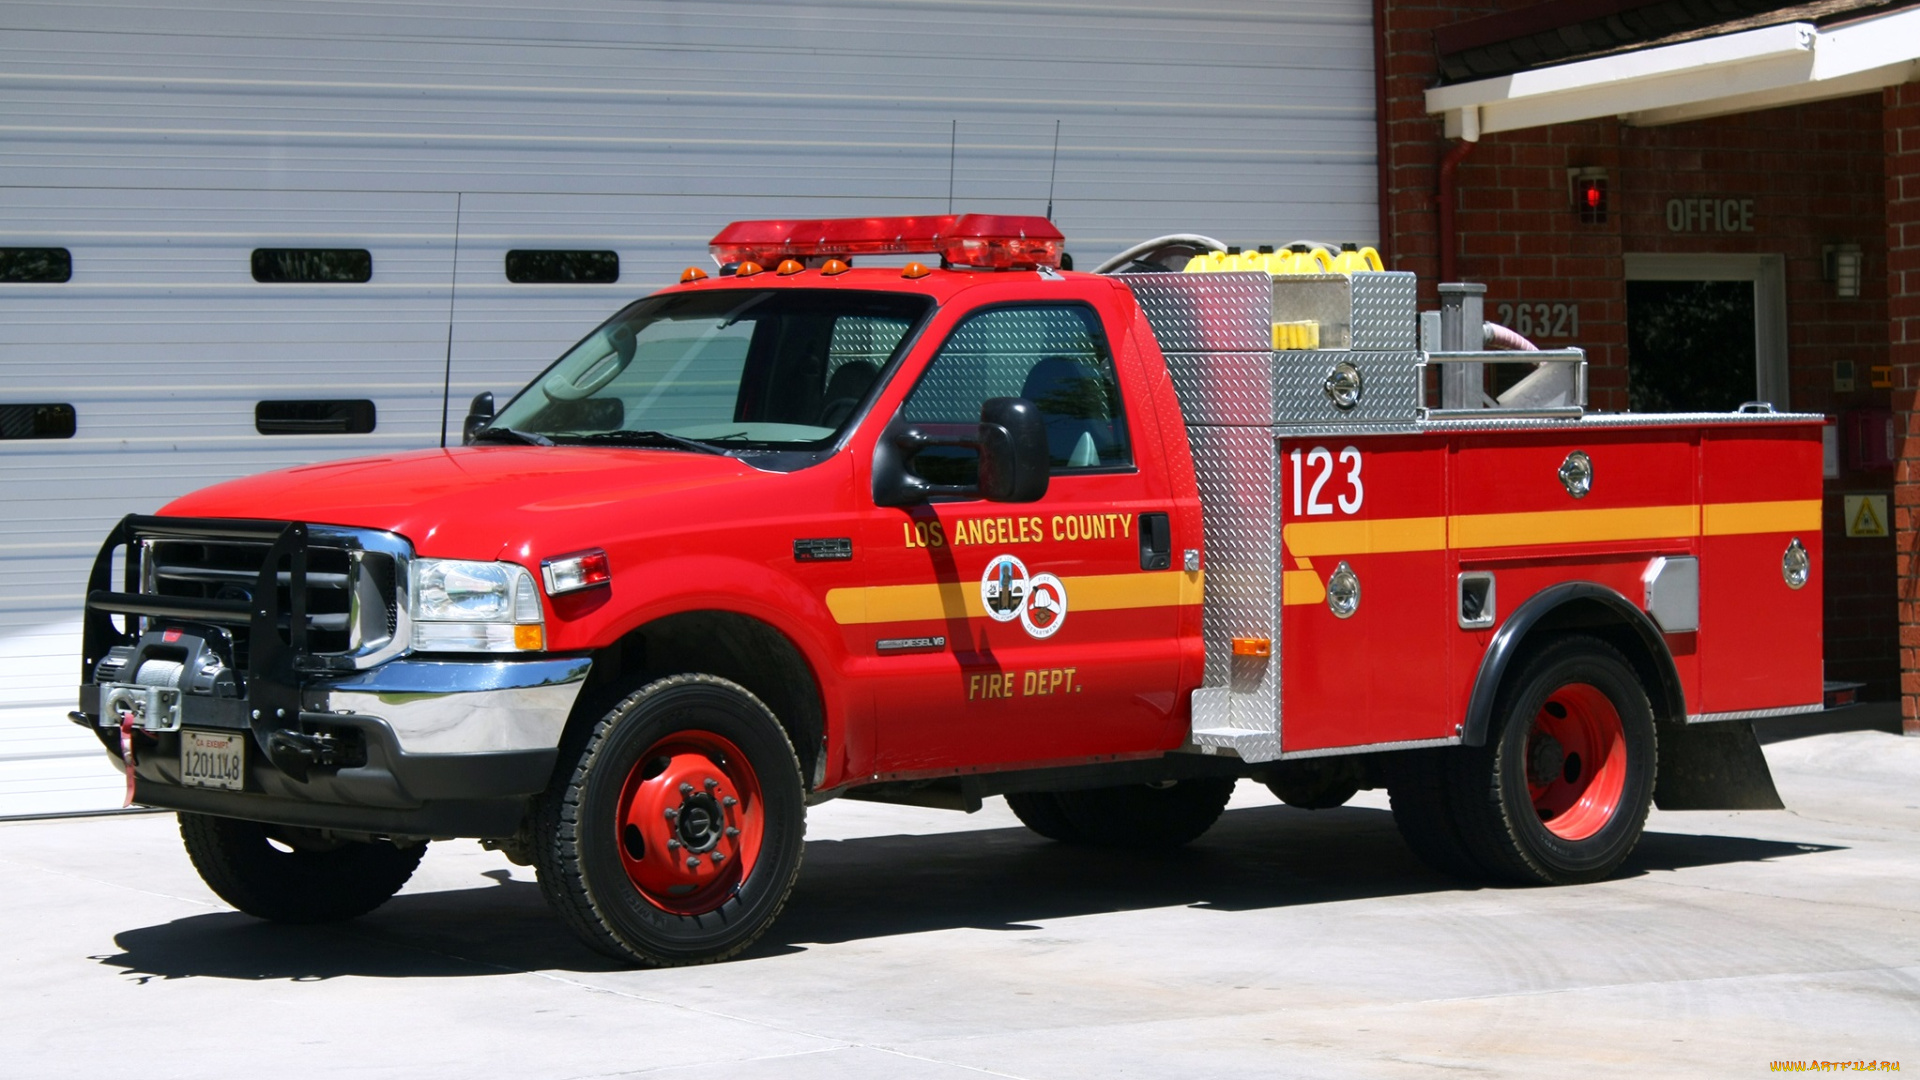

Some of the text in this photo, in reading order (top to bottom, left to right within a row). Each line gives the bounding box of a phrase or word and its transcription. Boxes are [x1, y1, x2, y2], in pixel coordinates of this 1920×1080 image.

[1666, 198, 1754, 233] OFFICE
[1497, 303, 1579, 338] 26321
[1290, 445, 1364, 516] 123
[903, 512, 1132, 549] LOS ANGELES COUNTY
[902, 638, 933, 647] DIESEL
[932, 636, 945, 646] V8
[1026, 620, 1060, 636] DEPARTMENT
[968, 667, 1082, 701] FIRE DEPT.
[207, 740, 229, 749] EXEMPT
[185, 751, 239, 780] 1201148
